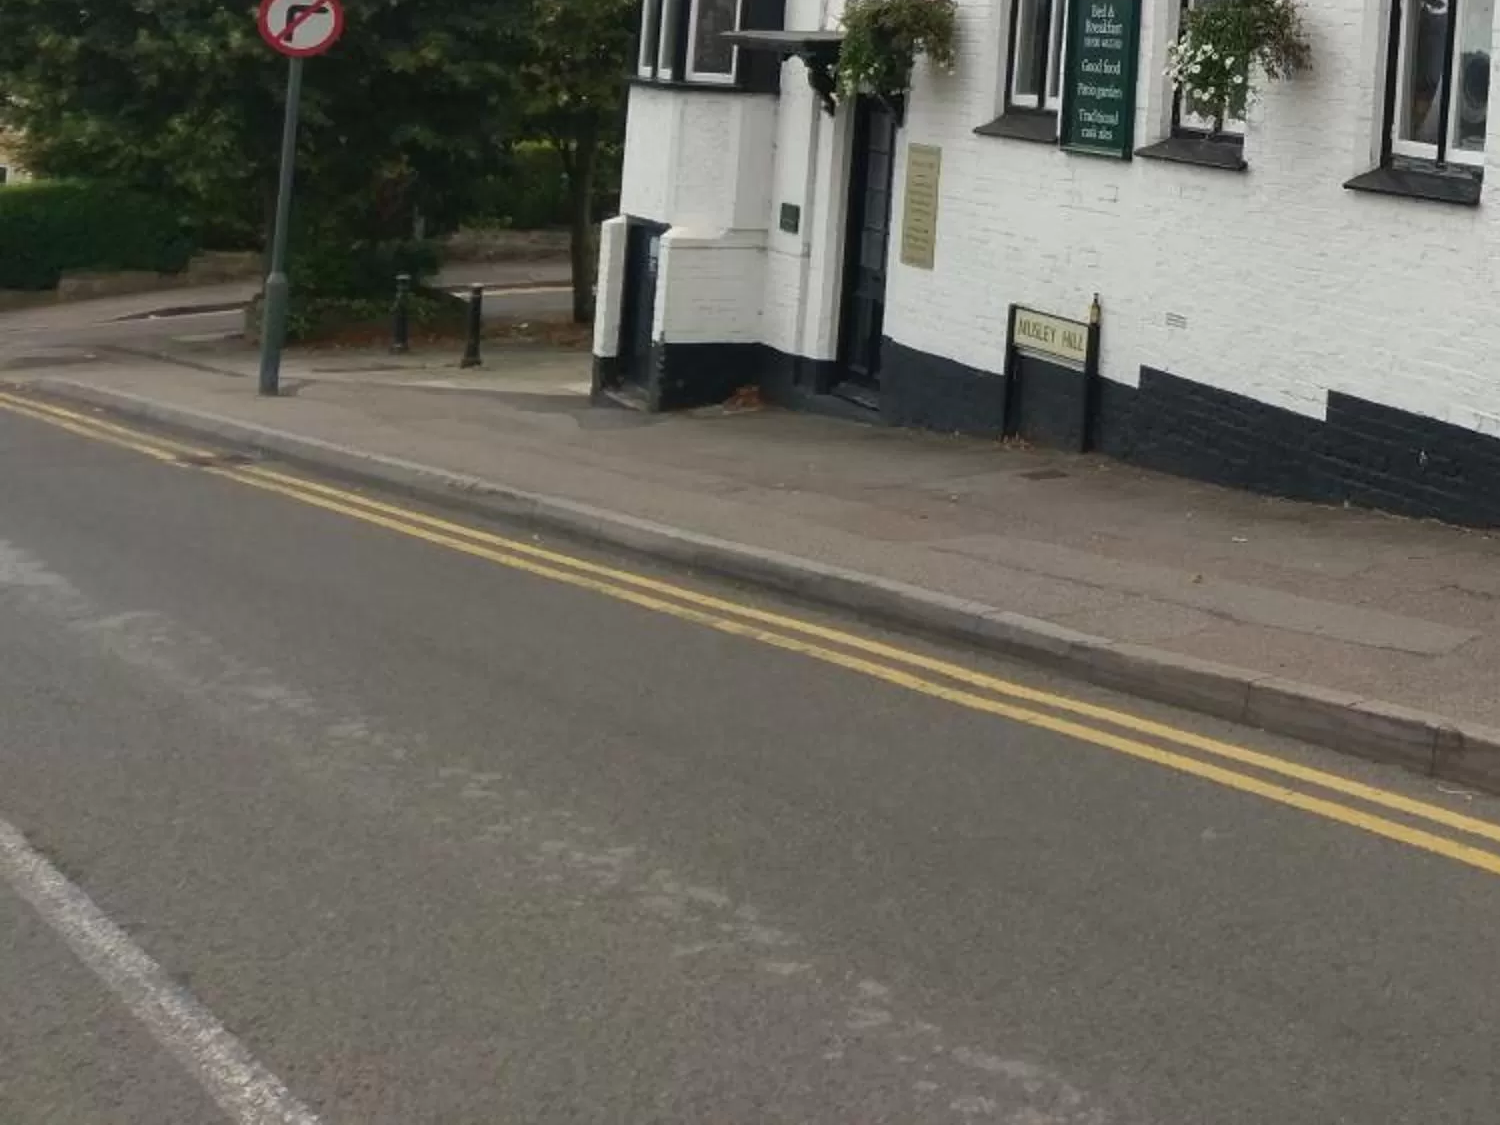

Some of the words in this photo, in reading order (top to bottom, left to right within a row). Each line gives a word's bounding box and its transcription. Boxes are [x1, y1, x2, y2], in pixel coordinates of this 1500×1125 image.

[1091, 3, 1107, 18] Bed
[1085, 18, 1123, 35] Breakfast
[1081, 58, 1103, 73] Good
[1103, 58, 1121, 75] food
[1079, 108, 1119, 125] Traditional
